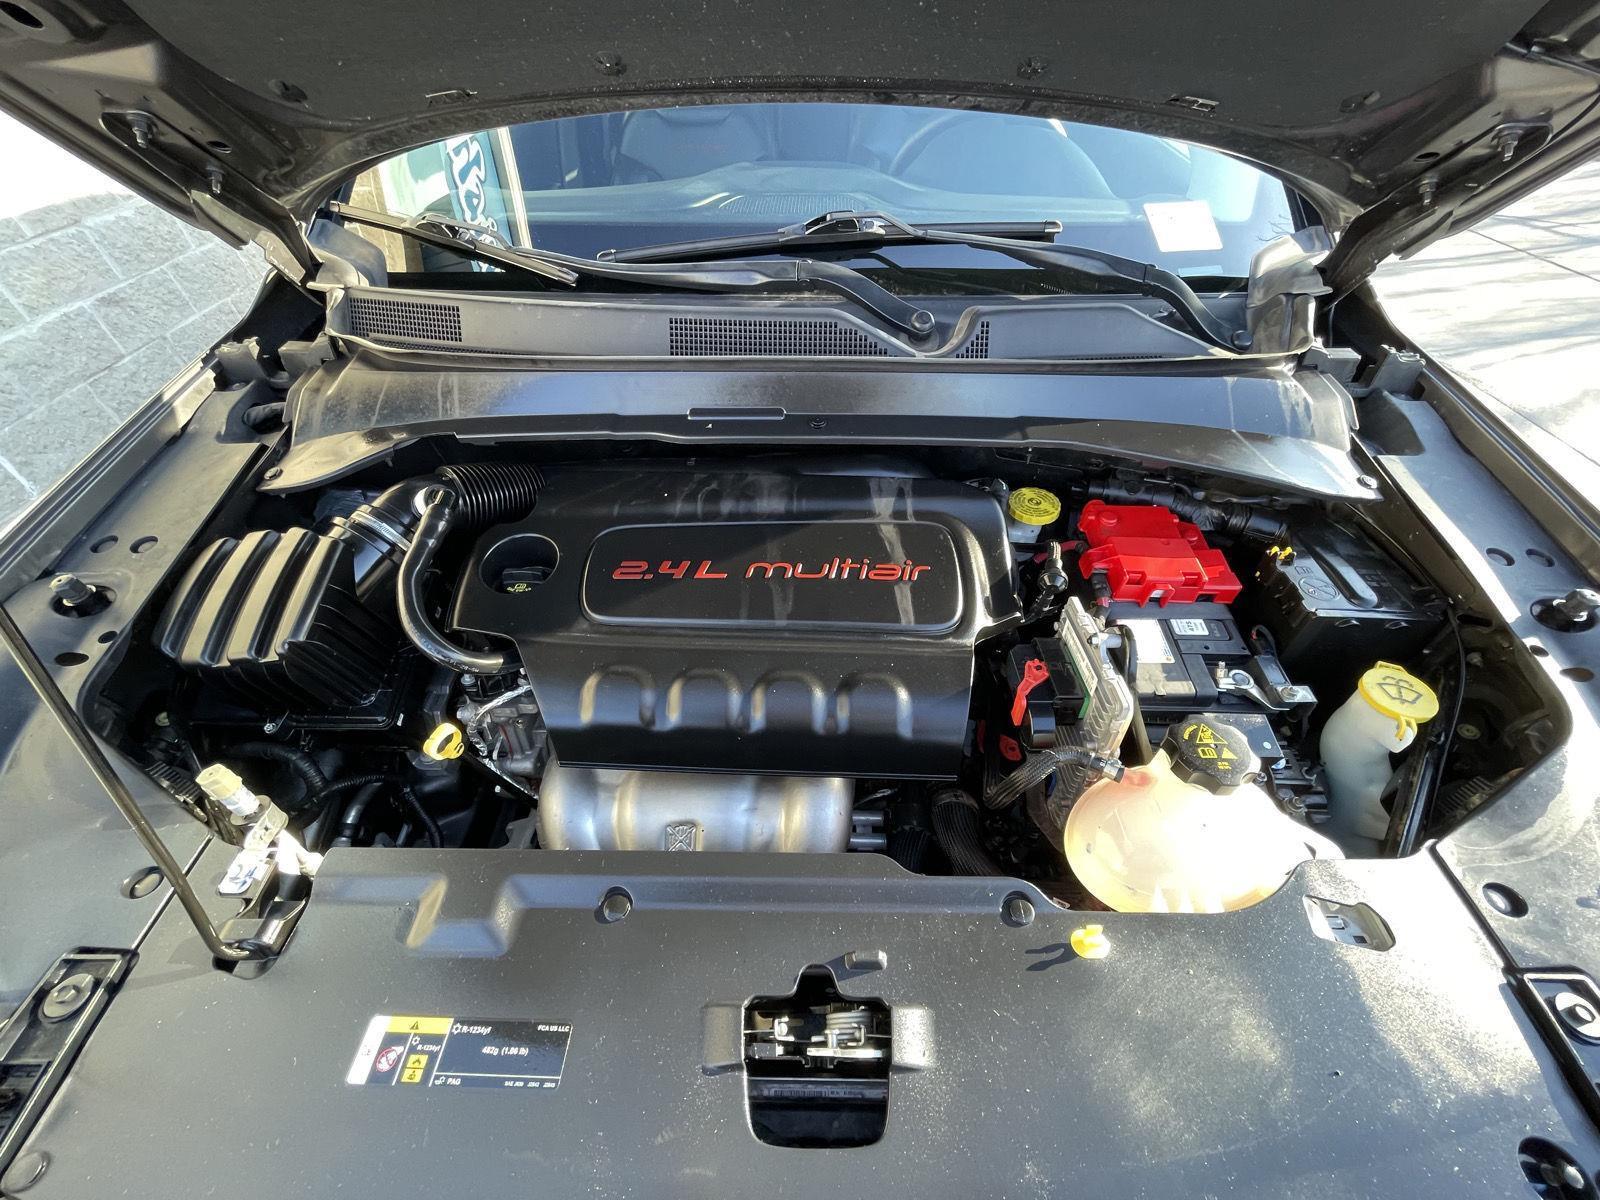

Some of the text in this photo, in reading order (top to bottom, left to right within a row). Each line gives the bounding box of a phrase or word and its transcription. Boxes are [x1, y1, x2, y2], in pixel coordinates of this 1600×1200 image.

[612, 557, 932, 582] 2.4L multiair
[461, 1025, 493, 1036] R-1234yf
[537, 1024, 550, 1032] FCA
[558, 1025, 570, 1033] LLC
[446, 1078, 461, 1086] PAG
